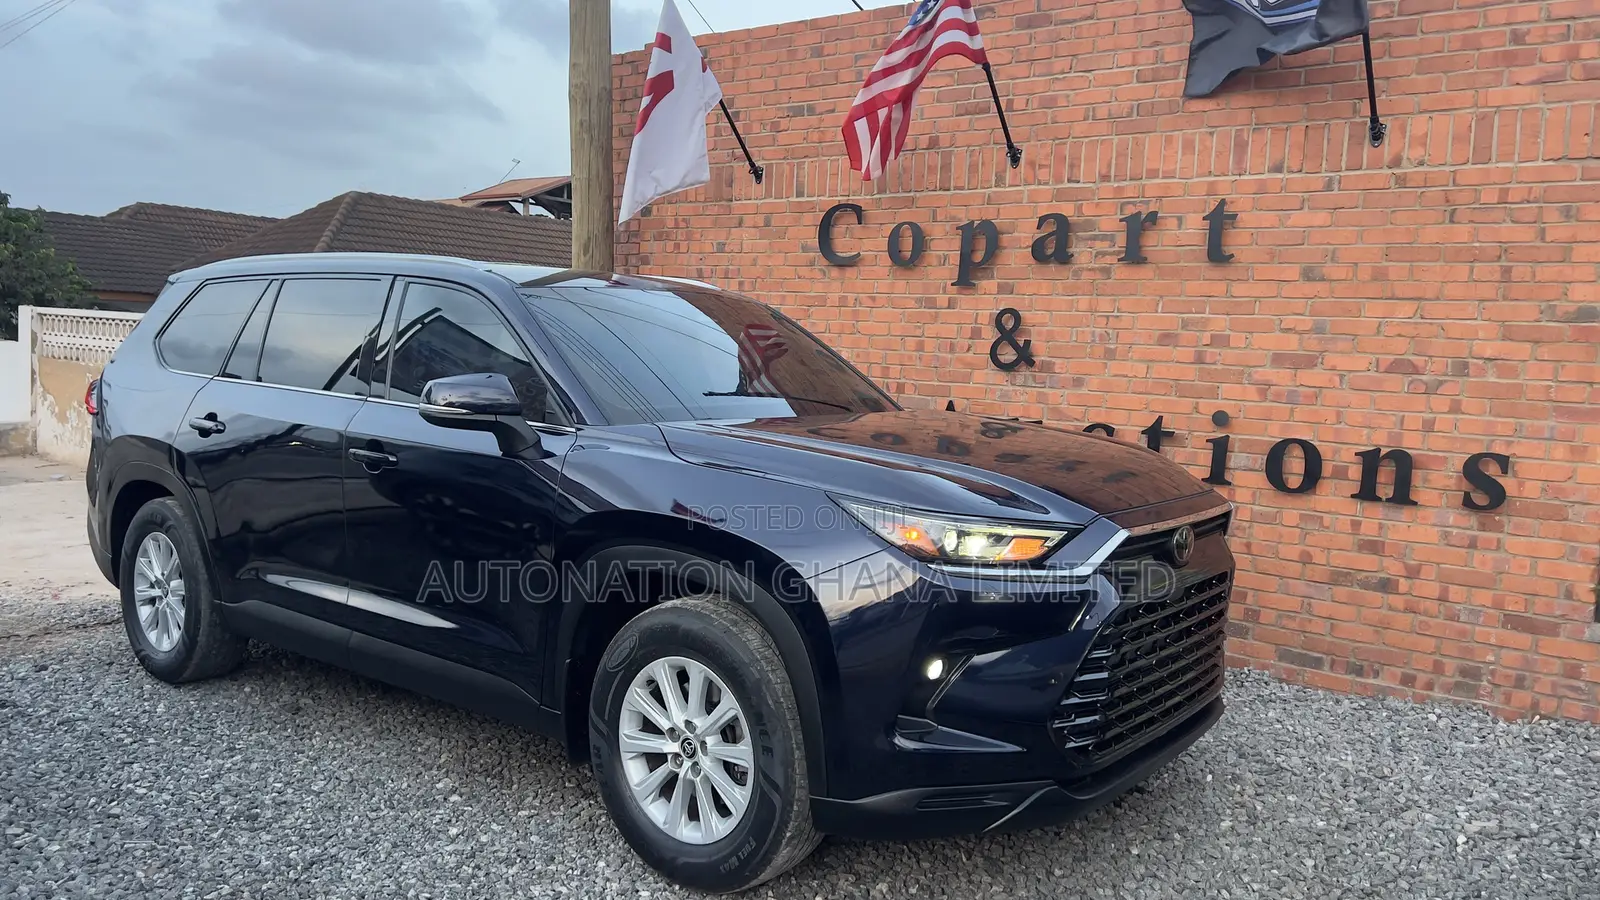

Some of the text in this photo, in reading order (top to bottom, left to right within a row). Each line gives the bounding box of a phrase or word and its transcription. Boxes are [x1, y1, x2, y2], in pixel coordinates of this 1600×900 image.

[817, 199, 1238, 287] Copart
[989, 307, 1036, 373] &
[945, 399, 1511, 511] tions
